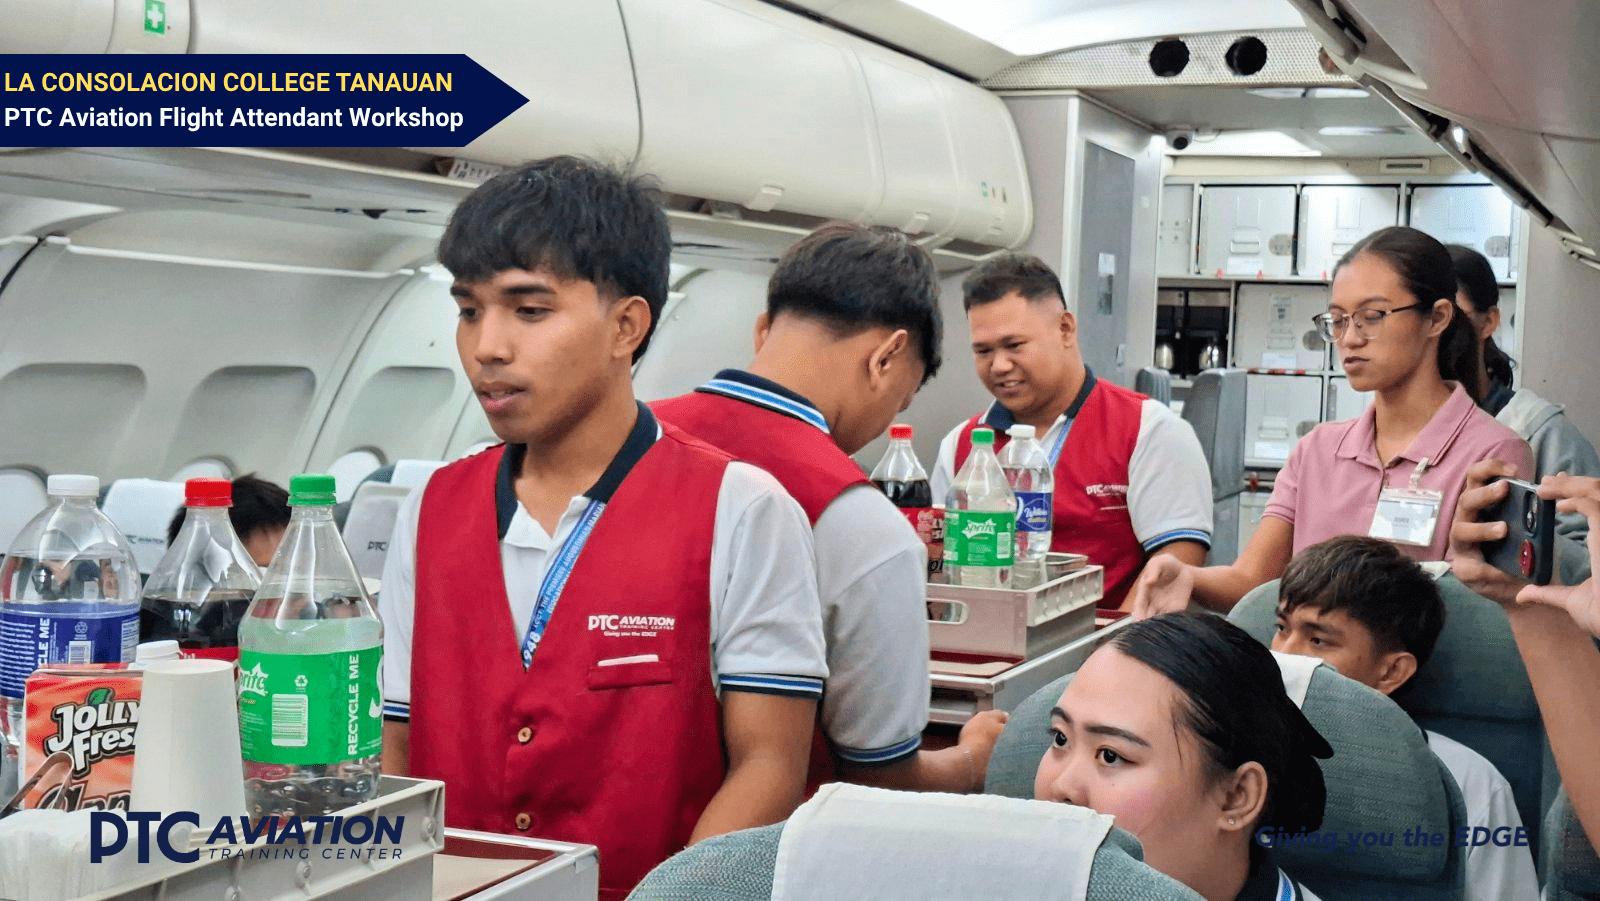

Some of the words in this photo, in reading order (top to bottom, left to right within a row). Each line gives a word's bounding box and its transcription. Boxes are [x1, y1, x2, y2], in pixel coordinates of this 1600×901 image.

[39, 618, 50, 638] ME
[588, 615, 619, 630] PTC
[619, 616, 675, 625] AVIATION
[349, 654, 359, 680] ME
[348, 683, 359, 755] RECYCLE
[73, 727, 137, 771] Fres
